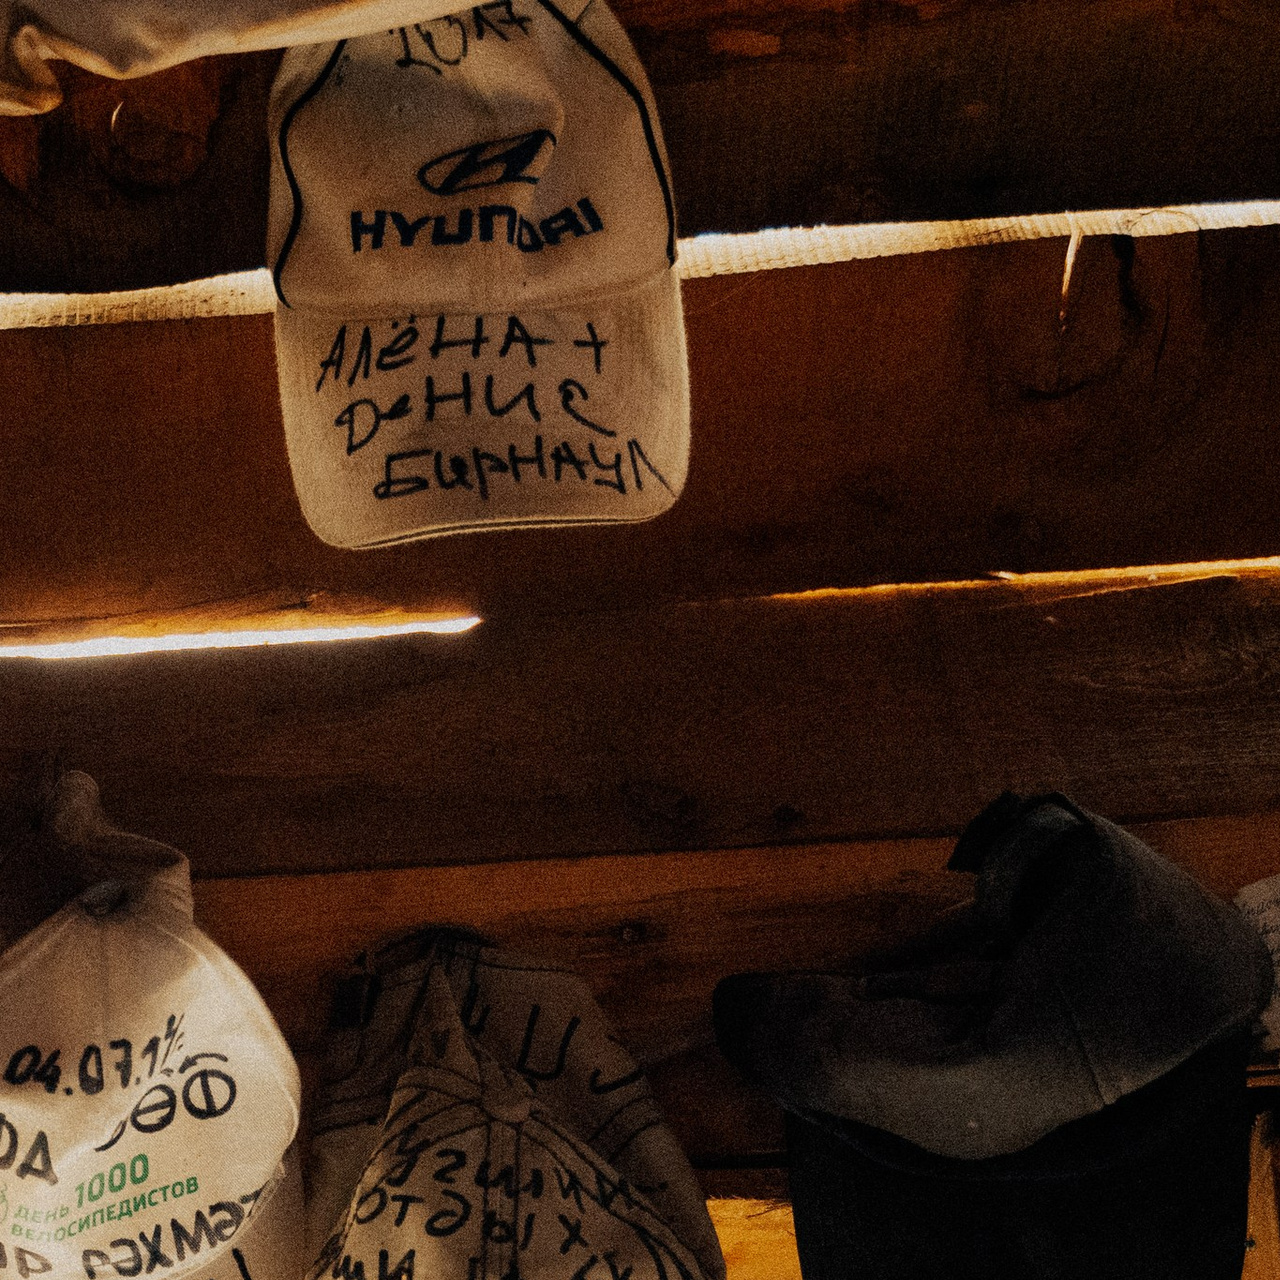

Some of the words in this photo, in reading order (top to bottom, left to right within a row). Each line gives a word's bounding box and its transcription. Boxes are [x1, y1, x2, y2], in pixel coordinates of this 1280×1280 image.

[351, 198, 604, 253] HYUNDAI
[10, 1176, 200, 1242] ВЕЛОСИПЕДИСТОВ
[14, 1203, 69, 1225] ДЕНЬ
[75, 1153, 150, 1209] 1000
